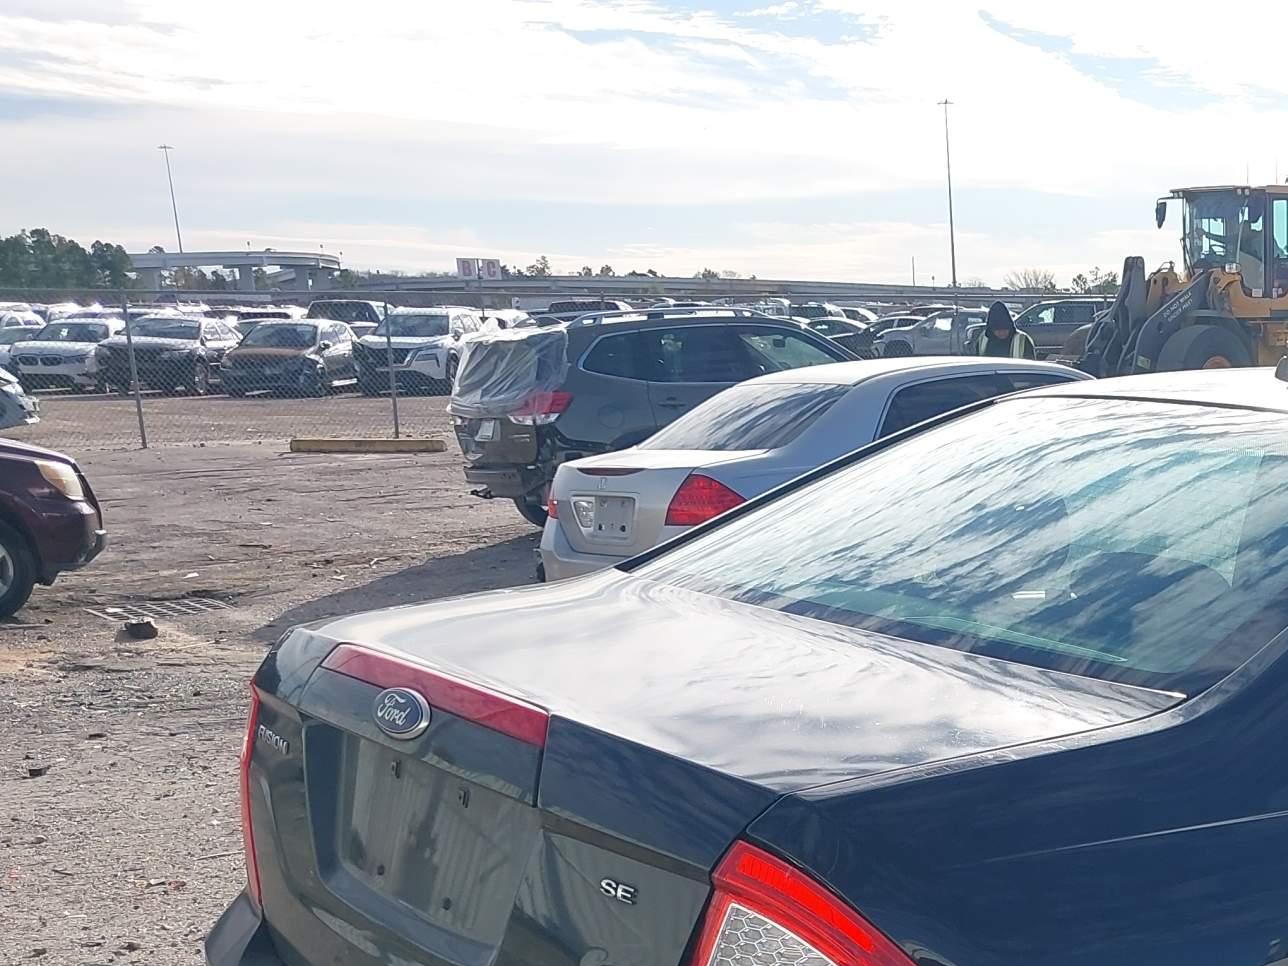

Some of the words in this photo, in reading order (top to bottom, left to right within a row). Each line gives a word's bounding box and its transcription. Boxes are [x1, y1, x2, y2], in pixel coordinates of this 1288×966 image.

[486, 261, 497, 278] C
[377, 693, 411, 726] Ford
[257, 723, 290, 755] FUSION
[599, 879, 635, 905] SE
